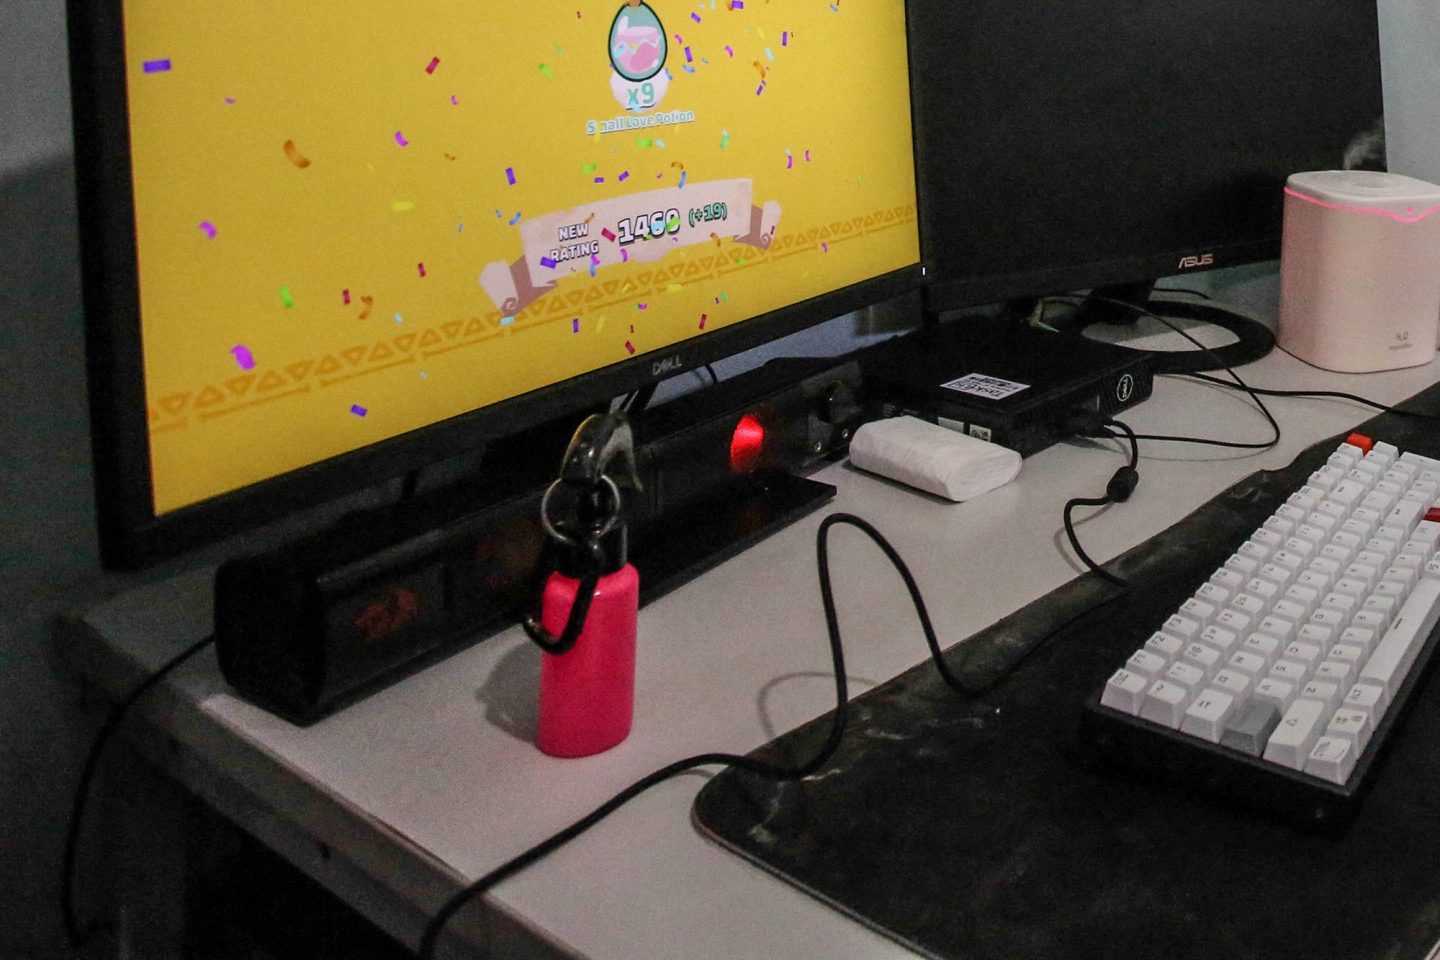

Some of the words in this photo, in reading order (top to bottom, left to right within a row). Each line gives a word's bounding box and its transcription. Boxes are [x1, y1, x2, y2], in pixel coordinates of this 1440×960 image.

[626, 115, 654, 129] Love
[656, 110, 693, 125] Potion
[558, 223, 589, 241] NEW
[618, 208, 680, 245] 1460
[688, 202, 727, 227] (+19)
[551, 241, 599, 262] RATING
[1178, 253, 1214, 269] ASUS
